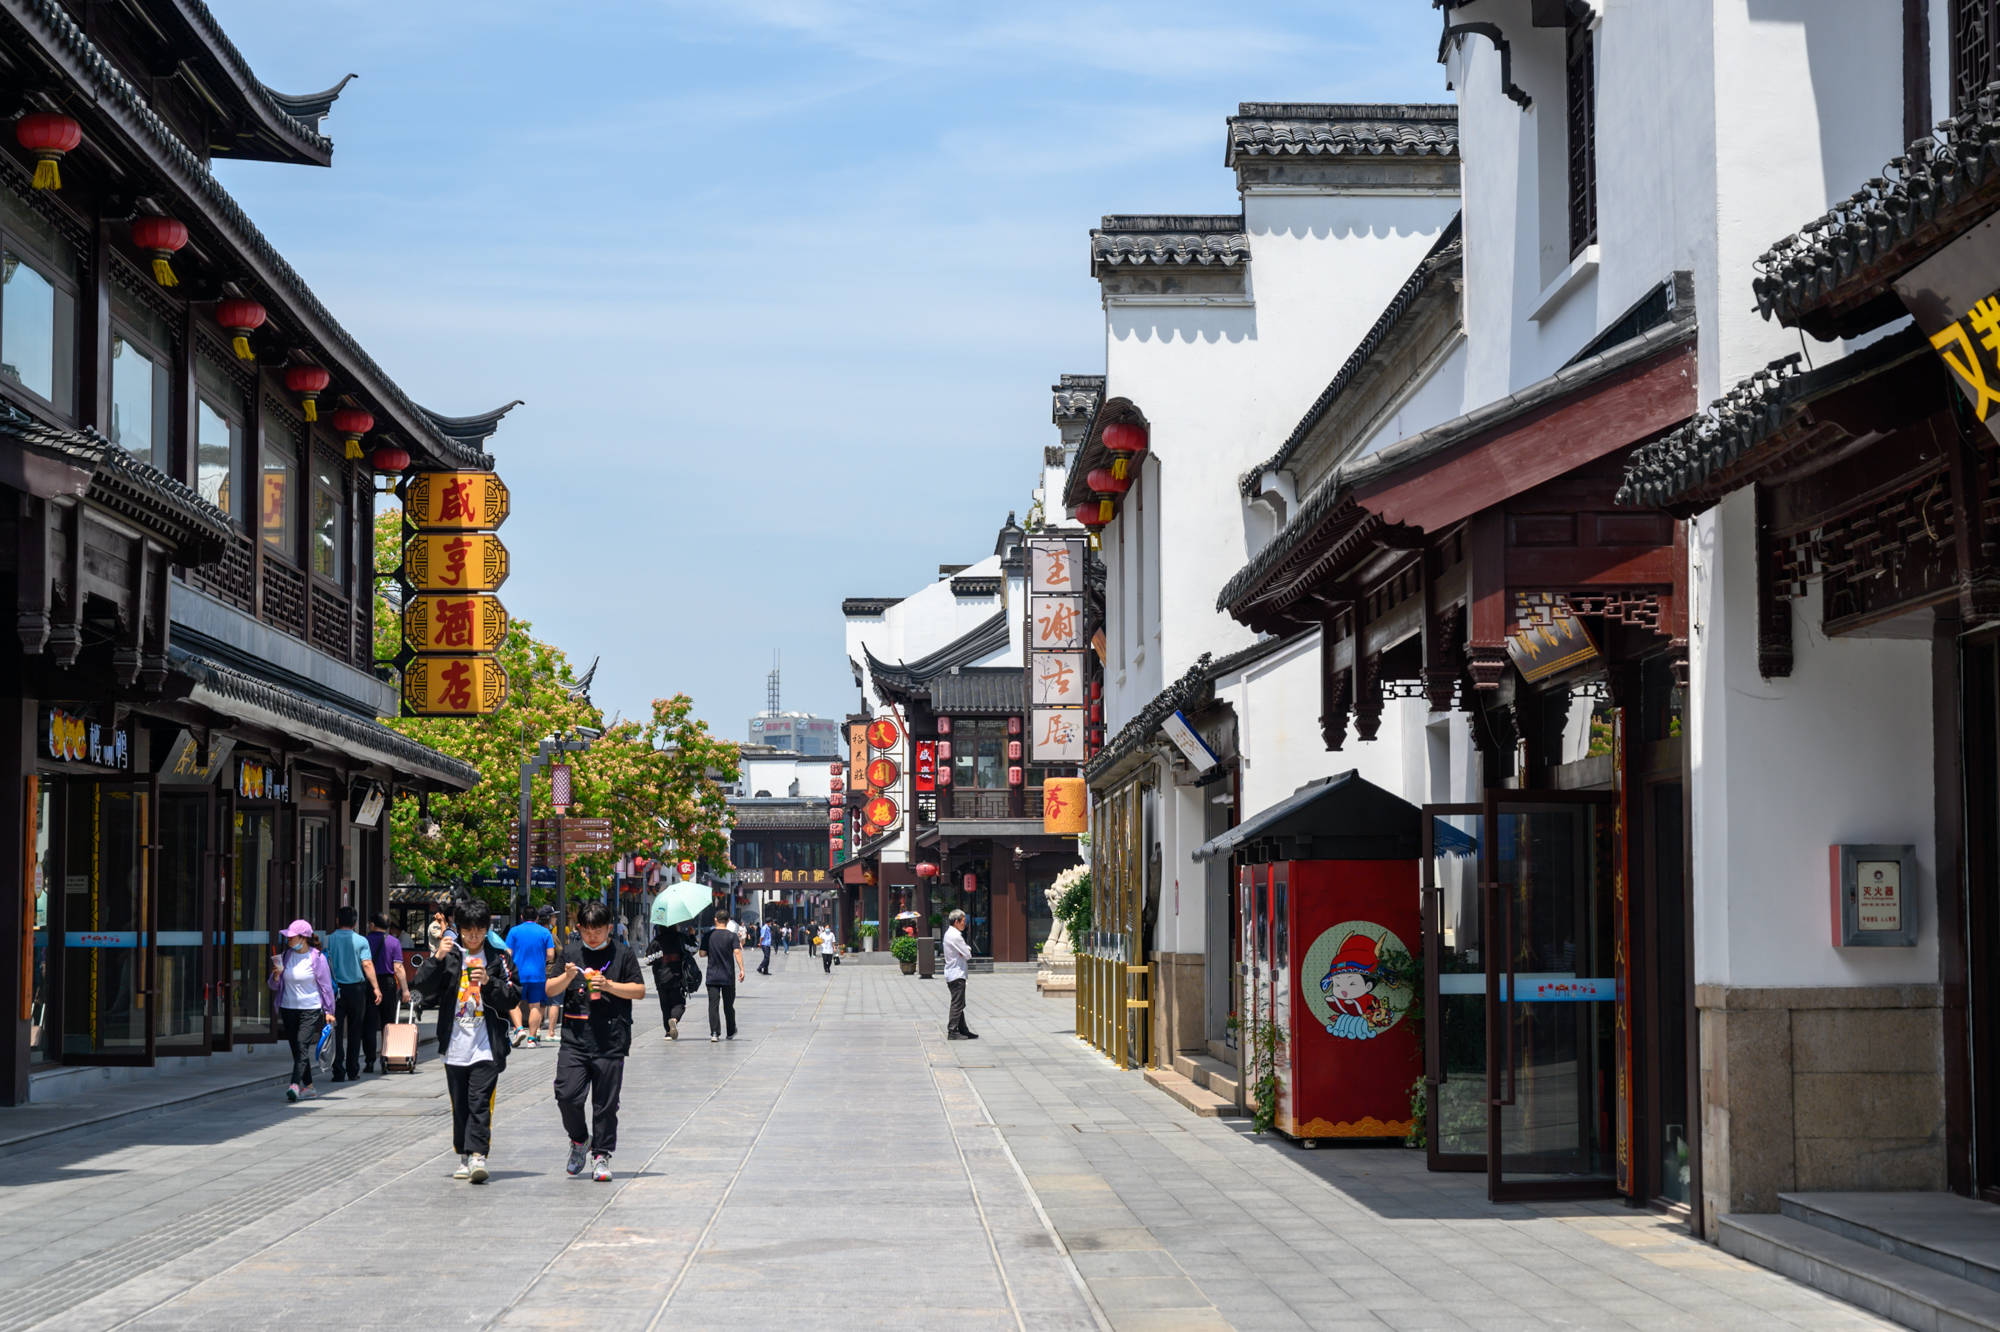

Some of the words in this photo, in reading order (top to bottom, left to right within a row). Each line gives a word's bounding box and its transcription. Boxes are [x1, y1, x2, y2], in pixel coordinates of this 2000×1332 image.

[434, 478, 475, 709] 咸亨酒店
[1864, 886, 1893, 897] 灭火器
